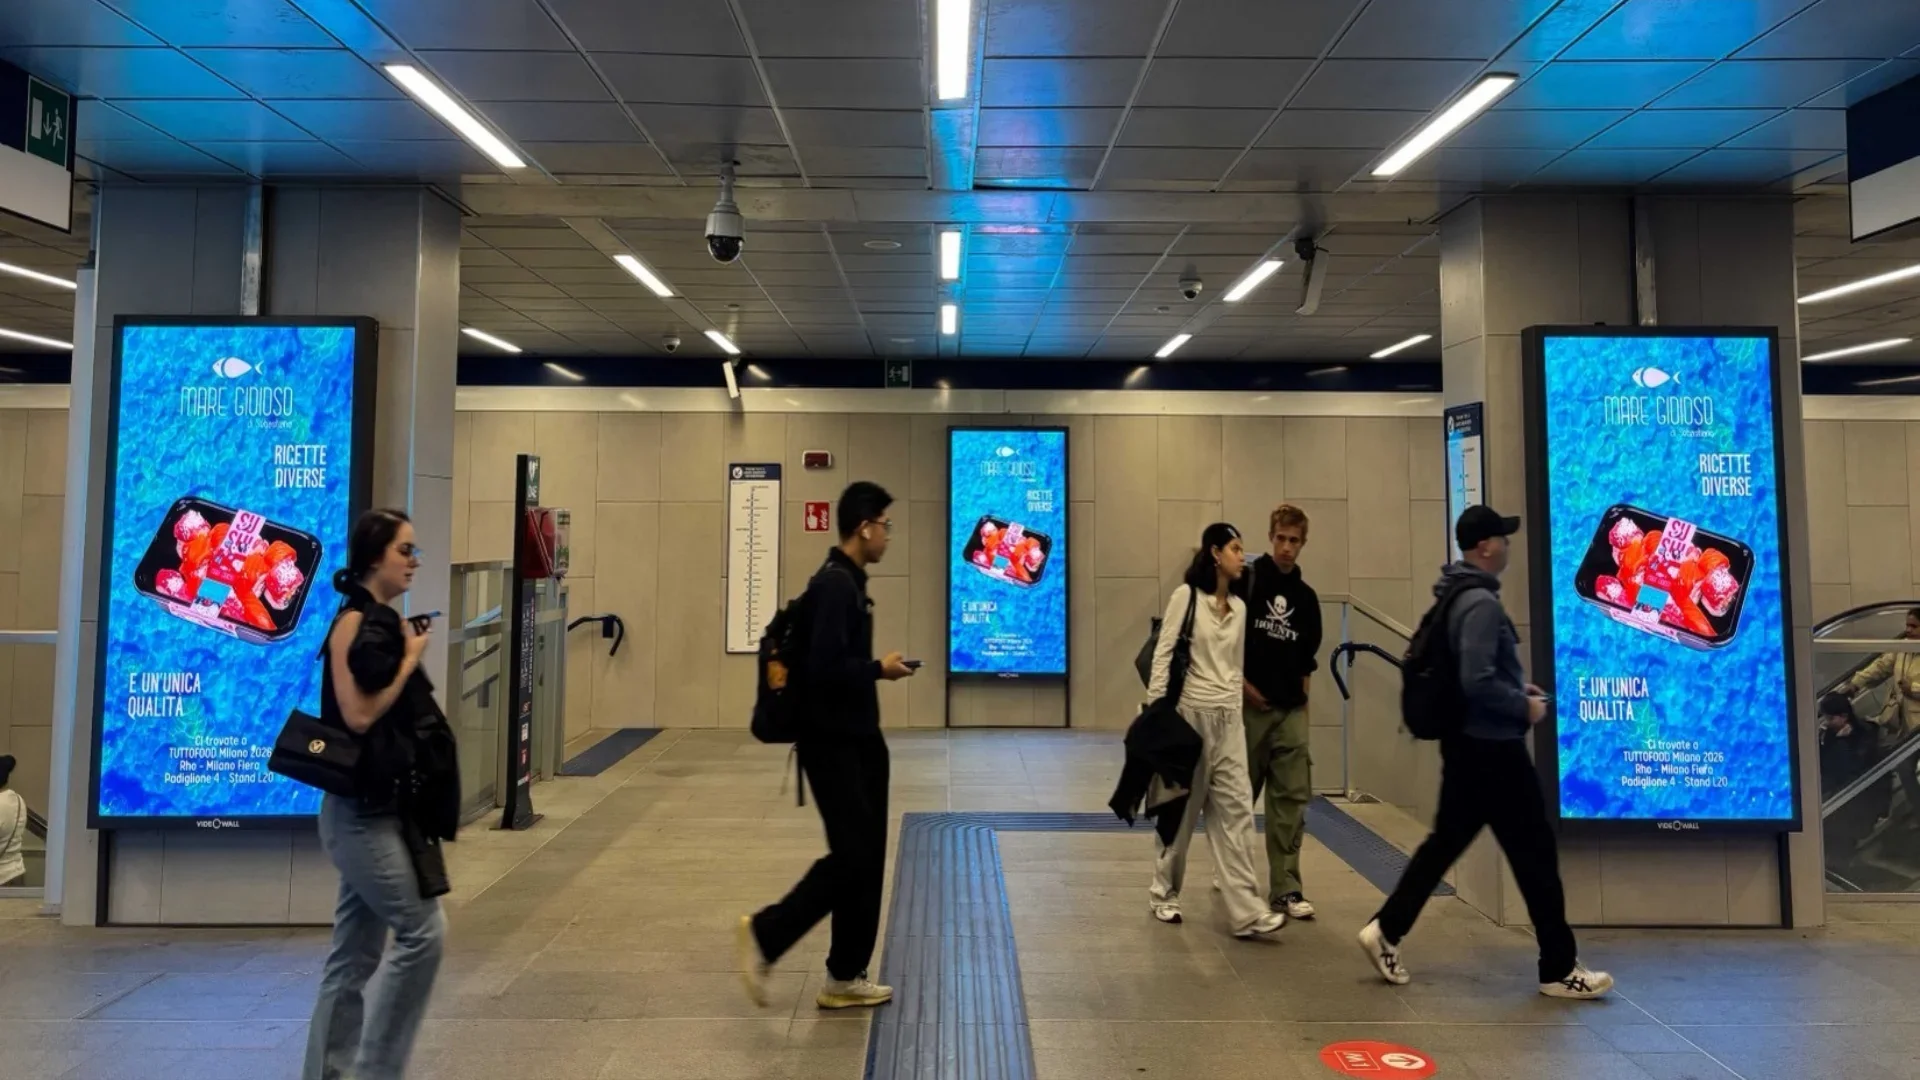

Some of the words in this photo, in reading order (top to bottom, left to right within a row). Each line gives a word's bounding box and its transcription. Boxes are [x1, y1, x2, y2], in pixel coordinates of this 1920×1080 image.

[180, 386, 228, 417] MARE
[234, 386, 293, 417] GIOIOSO
[1604, 396, 1649, 425] MARE
[1656, 396, 1714, 425] GIOIOSO
[274, 444, 327, 465] RICETTE
[1699, 453, 1751, 473] RICETTE
[275, 467, 327, 488] DIVERSE
[1702, 476, 1752, 496] DIVERSE
[128, 672, 137, 693] E
[142, 672, 201, 693] UN'UNICA
[1578, 677, 1587, 697] E
[1591, 676, 1649, 698] UN'UNICA
[195, 735, 203, 746] Ci
[205, 735, 240, 746] trovate
[241, 737, 248, 746] a
[1647, 739, 1656, 750] Ci
[1658, 739, 1691, 750] trovate
[1693, 741, 1699, 750] a
[169, 747, 217, 759] TUTTOFOOD
[219, 747, 249, 759] Milano
[250, 746, 273, 758] 2026
[1623, 751, 1670, 762] TUTTOFOOD
[1672, 751, 1701, 762] Milano
[1703, 752, 1724, 762] 2026
[180, 760, 197, 771] Rho
[206, 760, 236, 771] Milano
[237, 760, 260, 771] Fiera
[1635, 764, 1652, 774] Rho
[1661, 764, 1690, 775] Milano
[1691, 764, 1714, 775] Fiera
[164, 772, 212, 786] Padiglione
[213, 772, 220, 784] 4
[229, 772, 256, 784] Stand
[257, 772, 274, 784] L20
[1621, 776, 1668, 790] Padiglione
[1669, 776, 1676, 787] 4
[1684, 776, 1710, 787] Stand
[1712, 776, 1728, 787] L20
